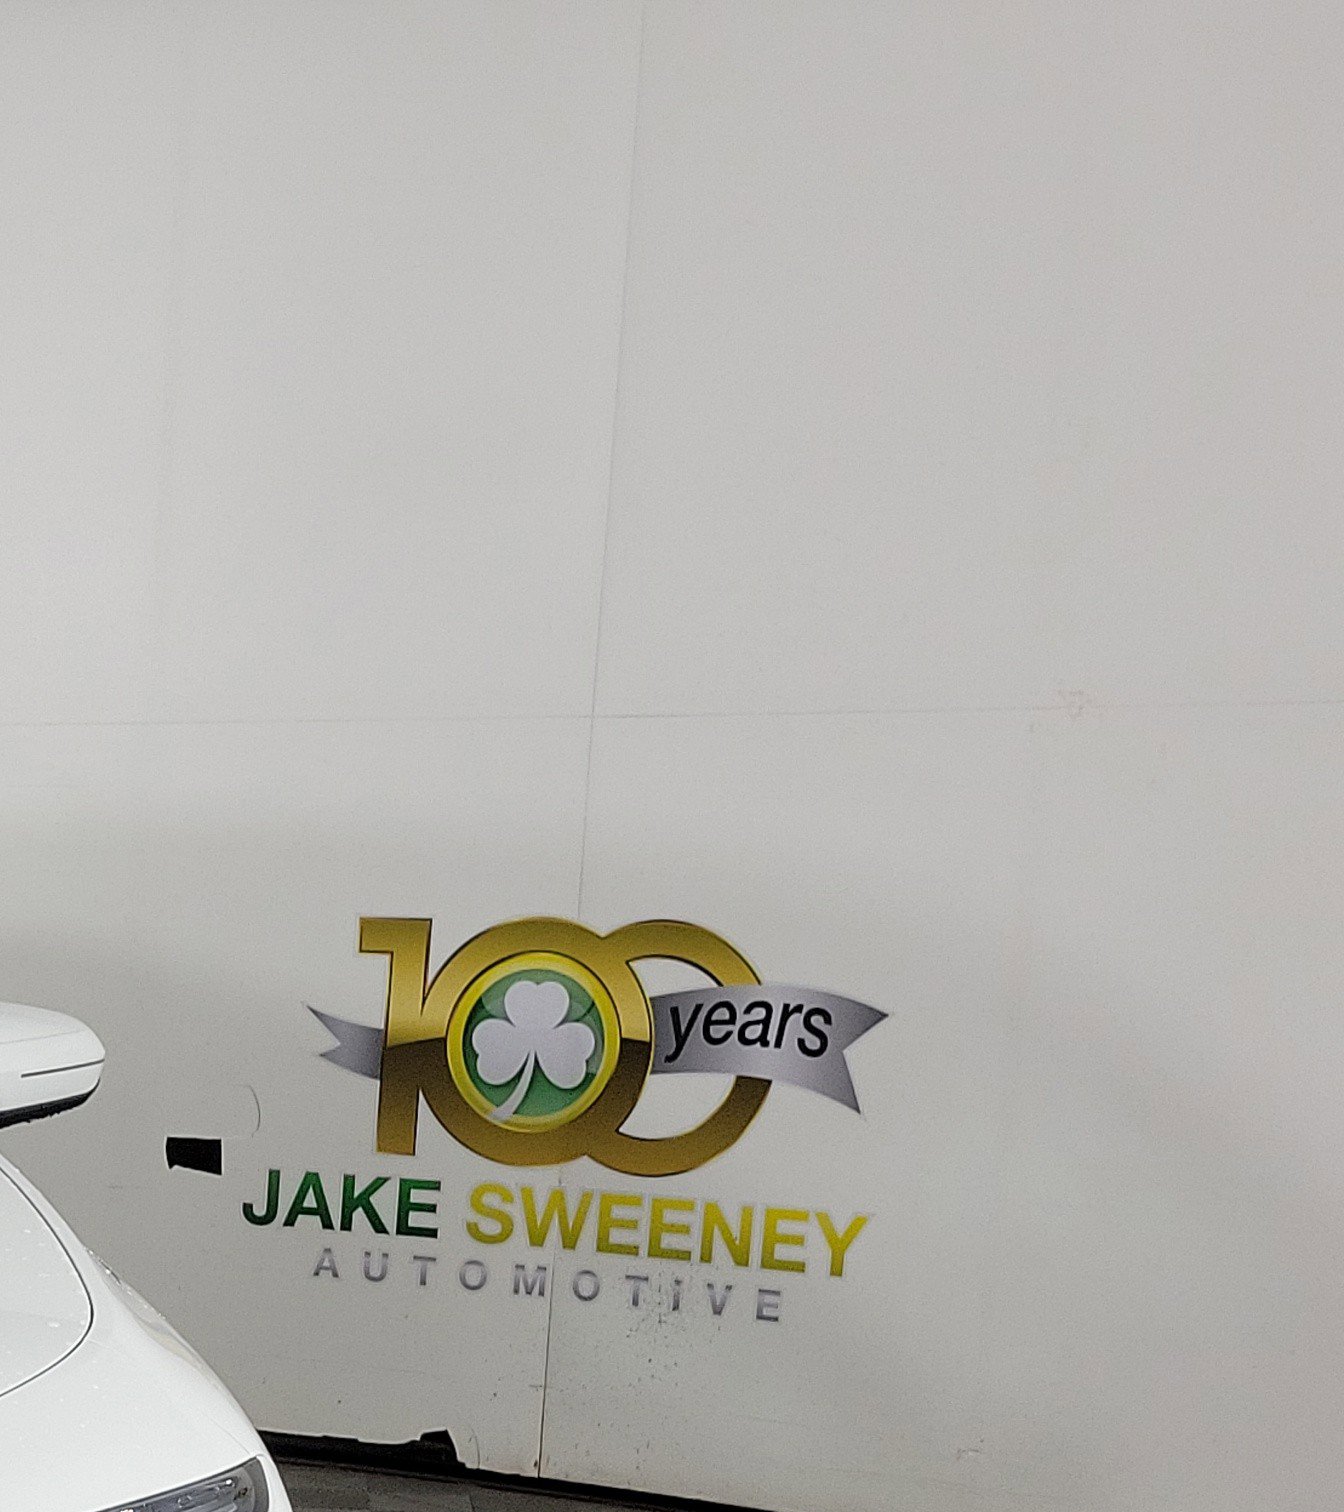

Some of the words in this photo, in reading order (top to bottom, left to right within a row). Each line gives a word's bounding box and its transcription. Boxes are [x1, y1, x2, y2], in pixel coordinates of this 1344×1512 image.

[359, 916, 772, 1176] 100
[664, 1000, 832, 1063] years
[242, 1169, 441, 1239] JAKE
[465, 1183, 868, 1277] SWEENEY
